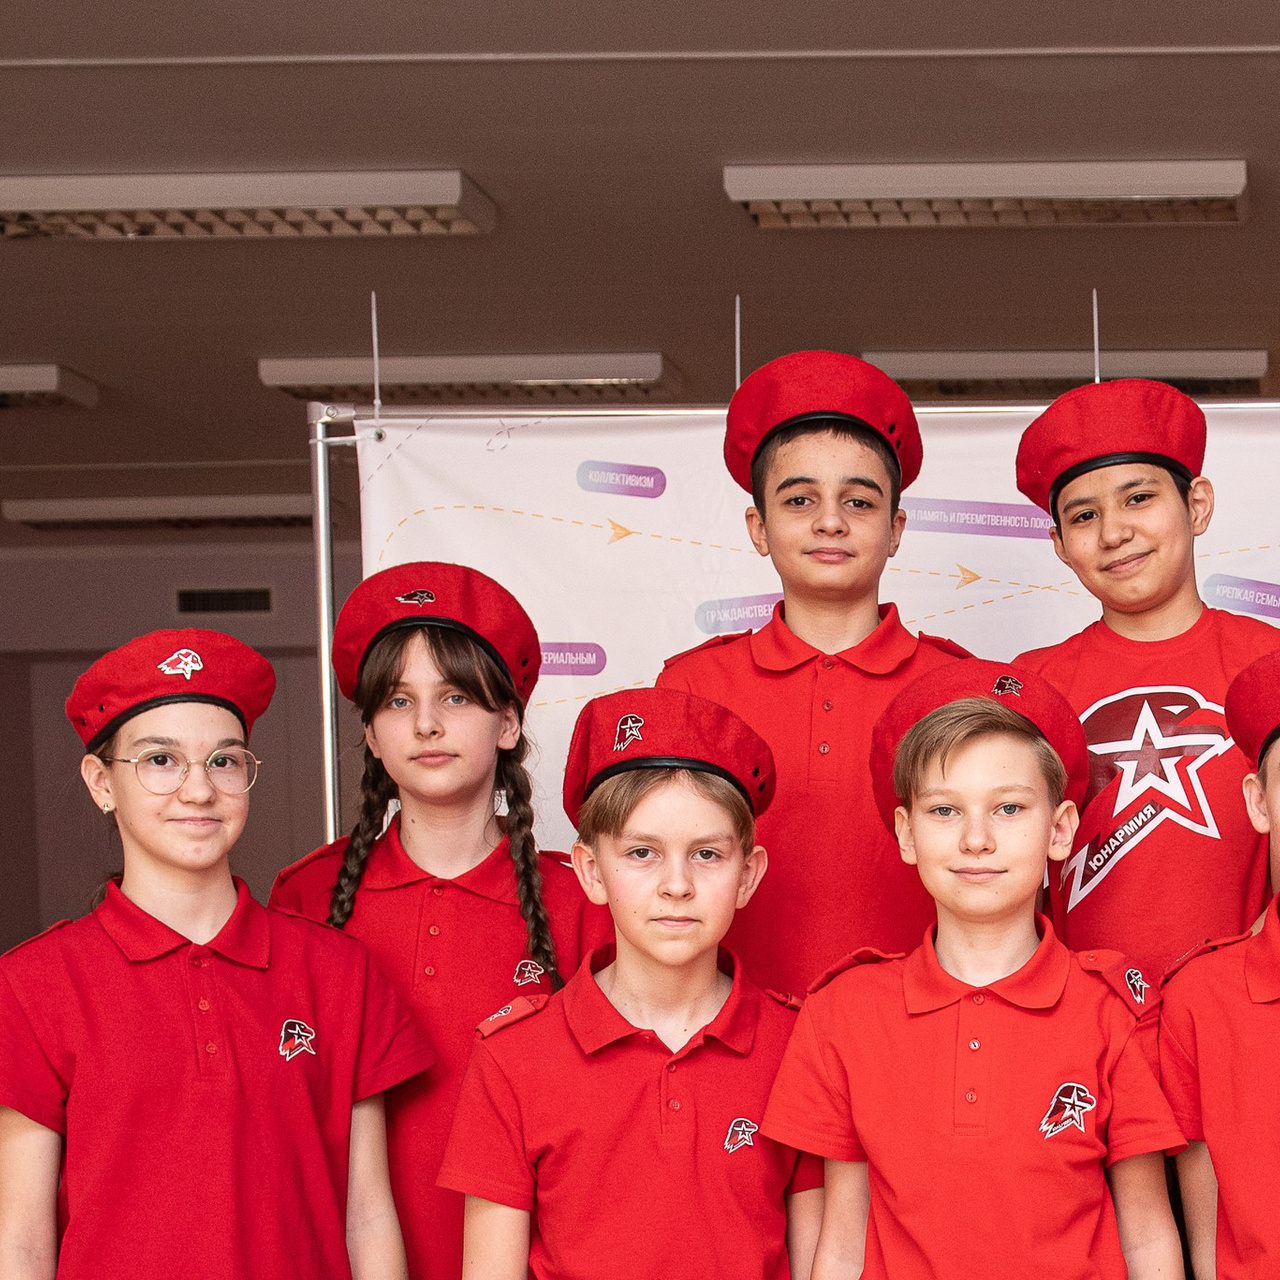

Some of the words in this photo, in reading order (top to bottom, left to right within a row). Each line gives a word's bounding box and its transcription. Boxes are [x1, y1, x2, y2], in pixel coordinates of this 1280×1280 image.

[588, 470, 654, 488] КОЛЛЕКТИВИЗМ
[917, 510, 948, 522] ПАМЯТЬ
[949, 512, 956, 523] И
[956, 512, 1029, 527] ПРЕЕМСТВЕННОСТЬ
[1216, 585, 1255, 603] КРЕПКАЯ
[1088, 804, 1157, 871] ЮНАРМИЯ
